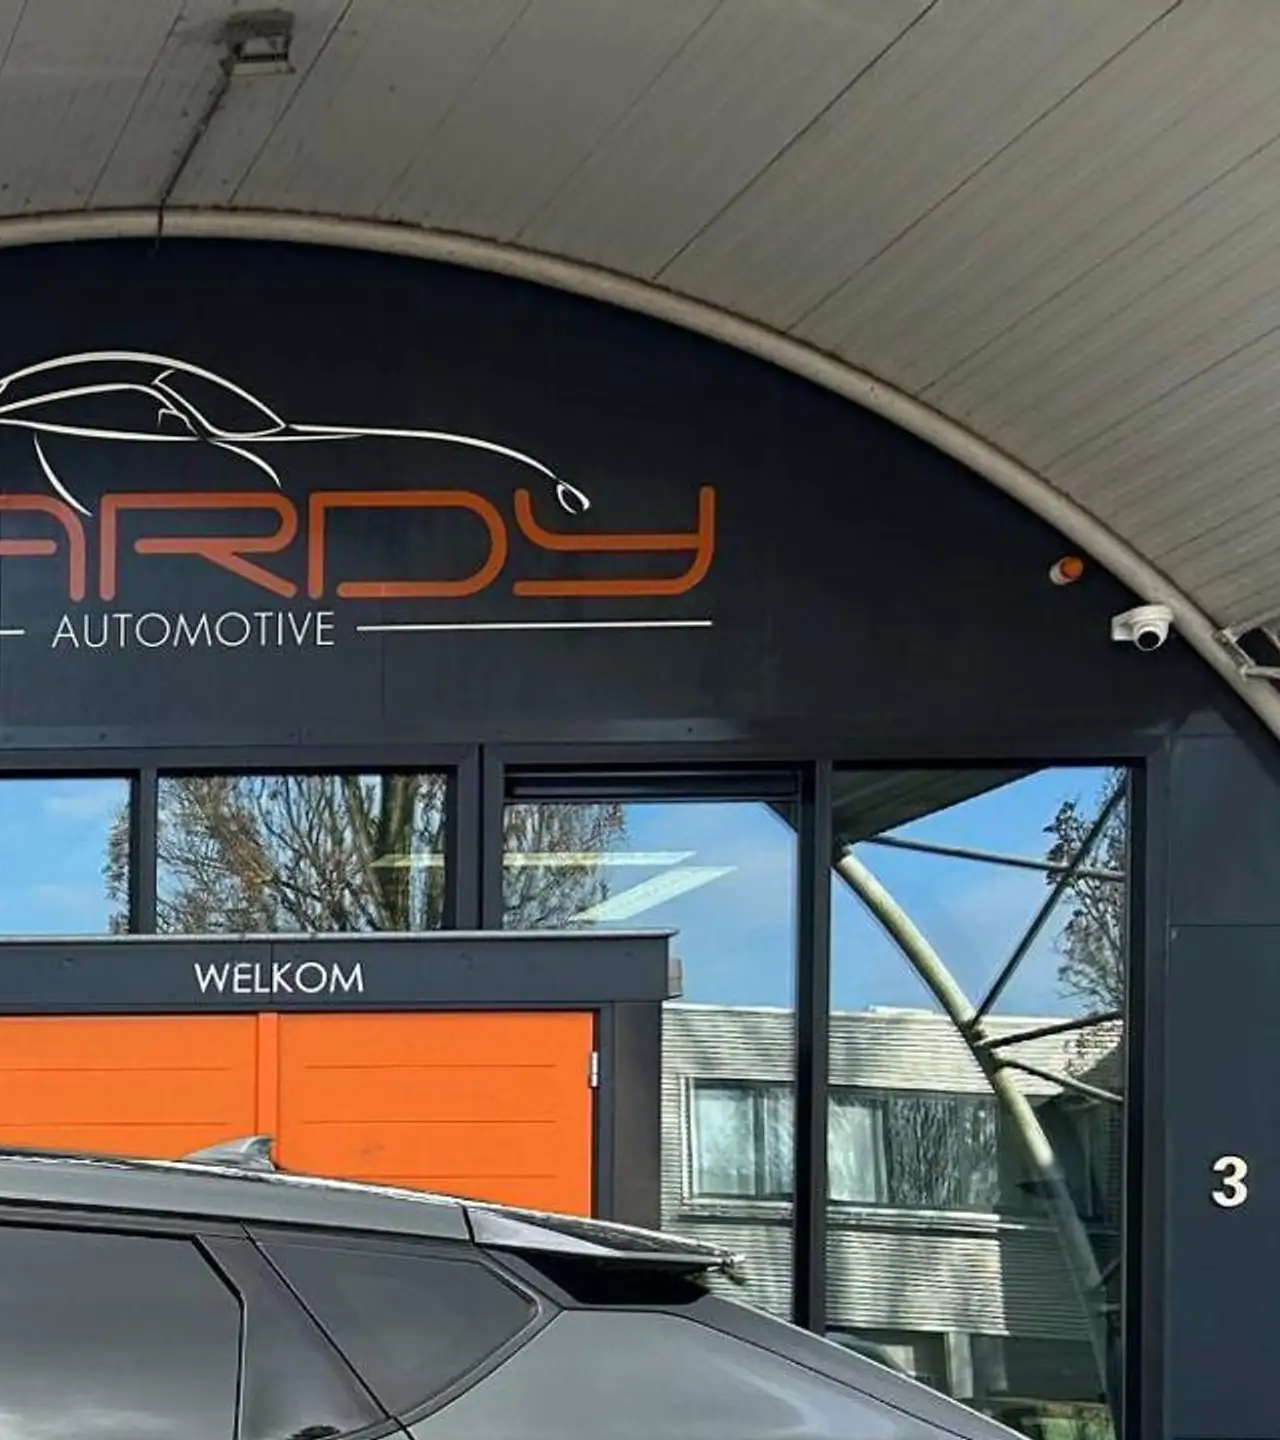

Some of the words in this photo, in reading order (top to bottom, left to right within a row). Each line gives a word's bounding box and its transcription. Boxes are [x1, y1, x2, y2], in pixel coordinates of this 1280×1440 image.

[51, 611, 336, 648] AUTOMOTIVE
[195, 962, 366, 994] WELKOM
[1211, 1155, 1249, 1208] 3
